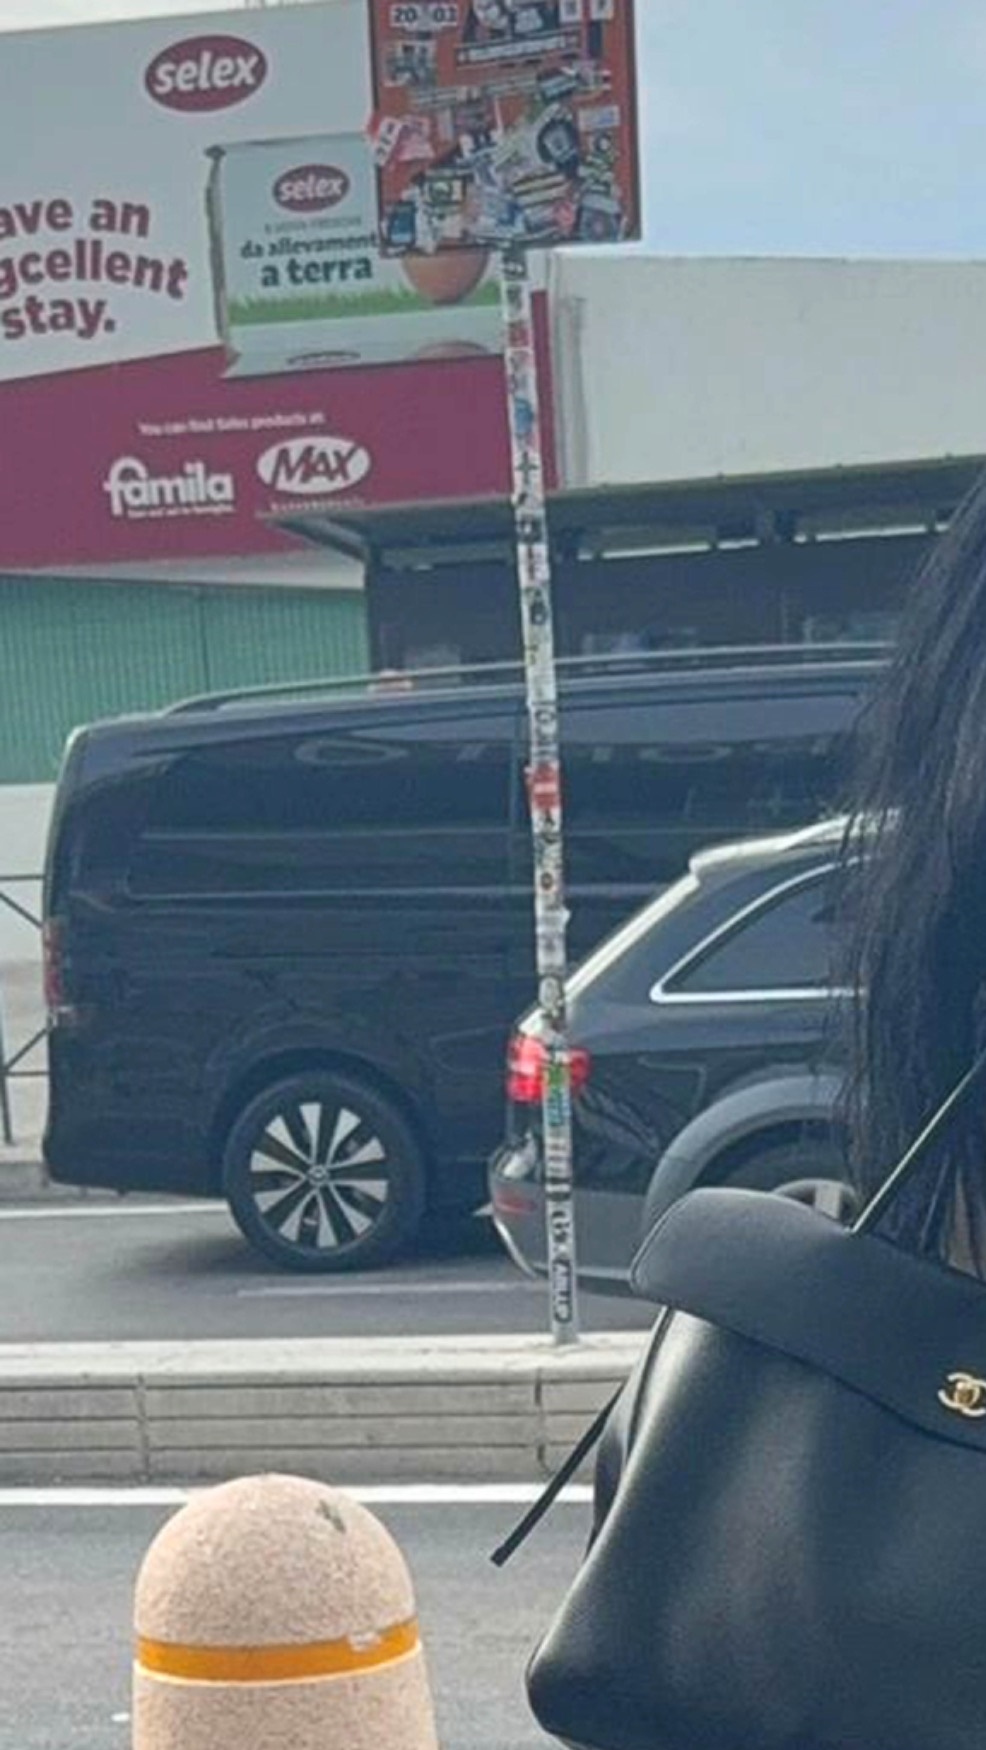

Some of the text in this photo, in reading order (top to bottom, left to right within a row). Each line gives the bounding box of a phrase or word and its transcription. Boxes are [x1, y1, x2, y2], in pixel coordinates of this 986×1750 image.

[153, 49, 259, 95] selex
[279, 173, 345, 201] selex
[89, 199, 150, 238] an
[240, 232, 378, 258] da allevament
[261, 256, 373, 287] a terra
[1, 295, 116, 340] stay.
[103, 456, 234, 516] famila
[269, 445, 359, 491] MAX
